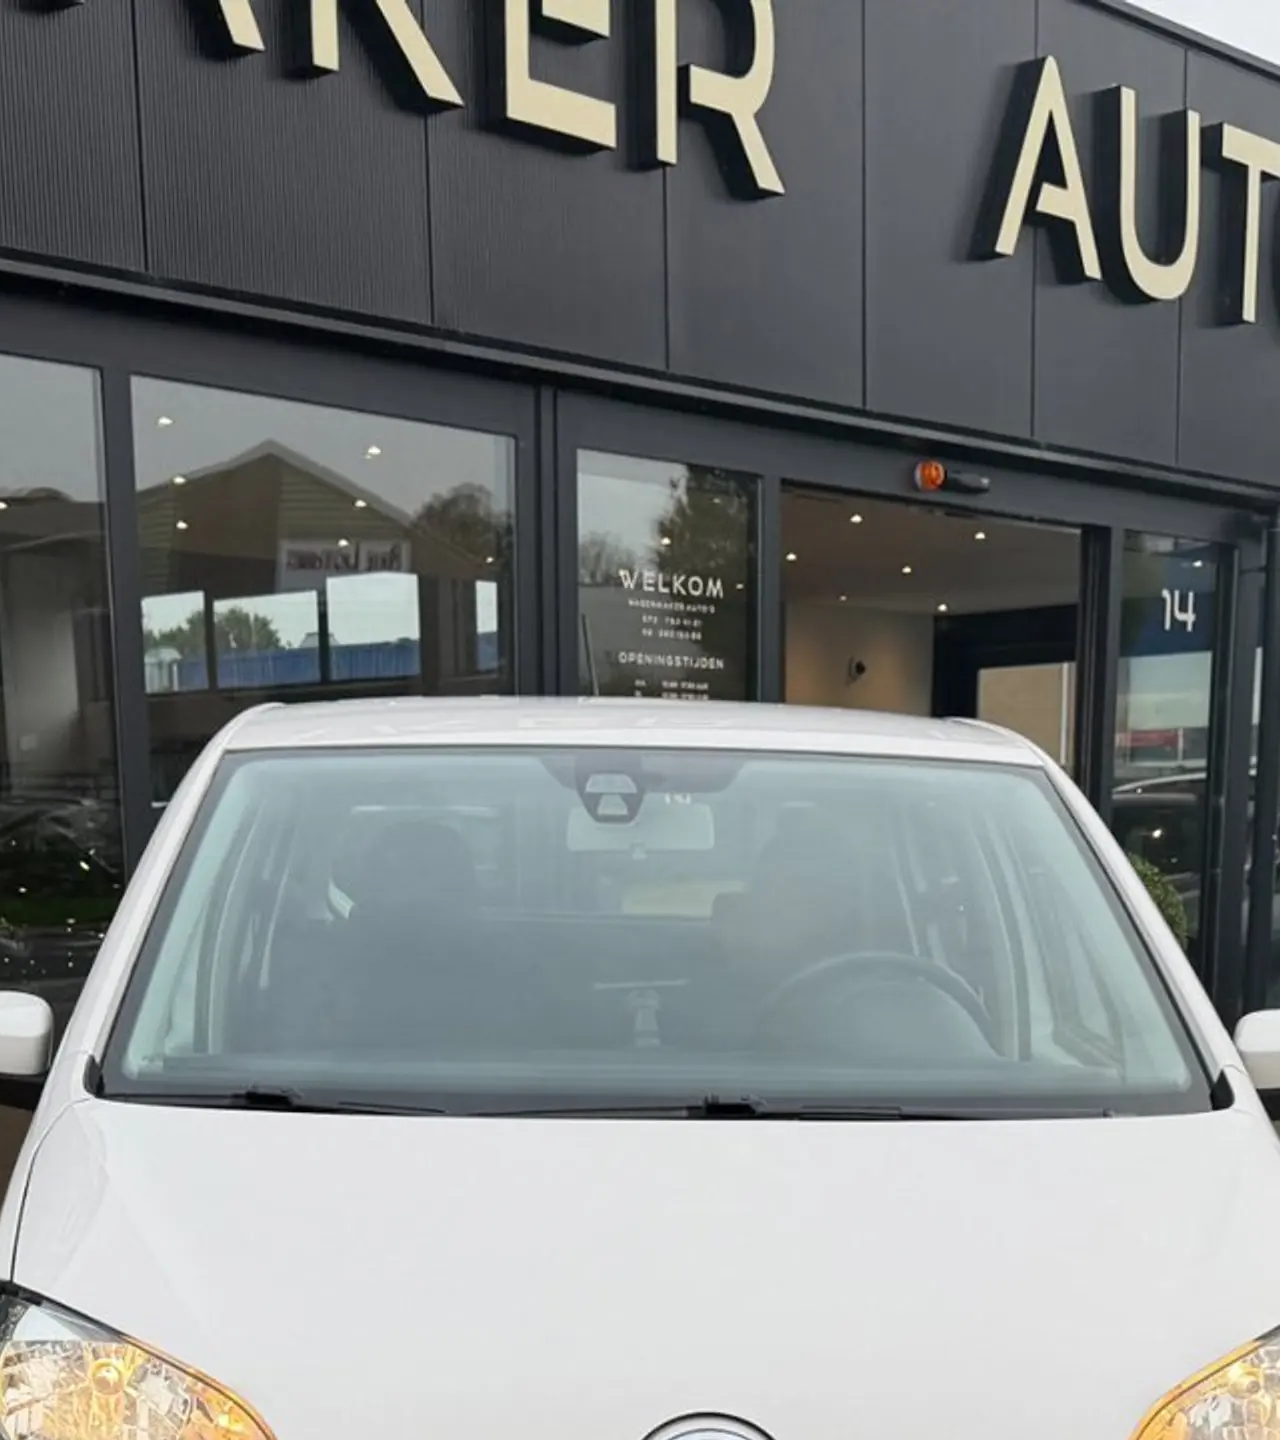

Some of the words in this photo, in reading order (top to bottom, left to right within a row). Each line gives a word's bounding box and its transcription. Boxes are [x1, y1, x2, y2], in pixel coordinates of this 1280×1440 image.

[618, 568, 724, 599] WELKOM
[1161, 588, 1197, 632] 14
[618, 651, 725, 670] OPENINGSTIJDEN
